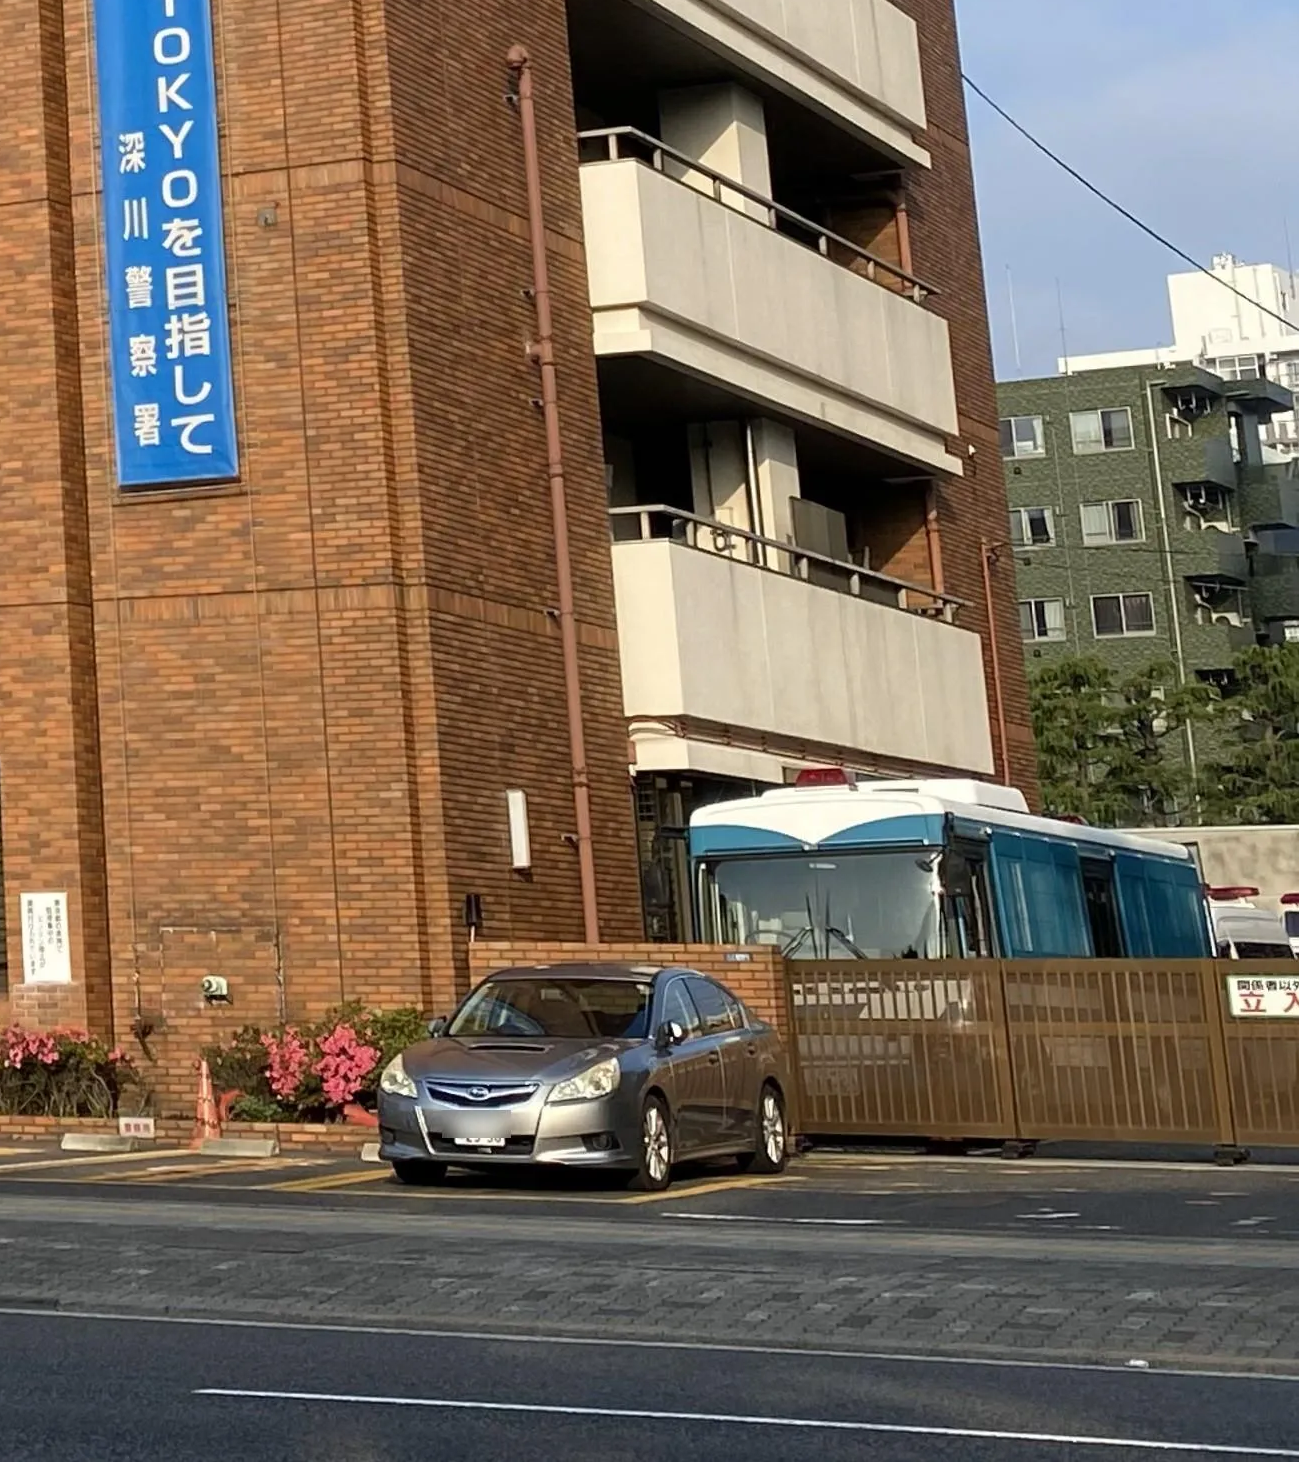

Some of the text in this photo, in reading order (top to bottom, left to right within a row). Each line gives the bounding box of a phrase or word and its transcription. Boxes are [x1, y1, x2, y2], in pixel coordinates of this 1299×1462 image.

[118, 131, 162, 448] 深川警察署
